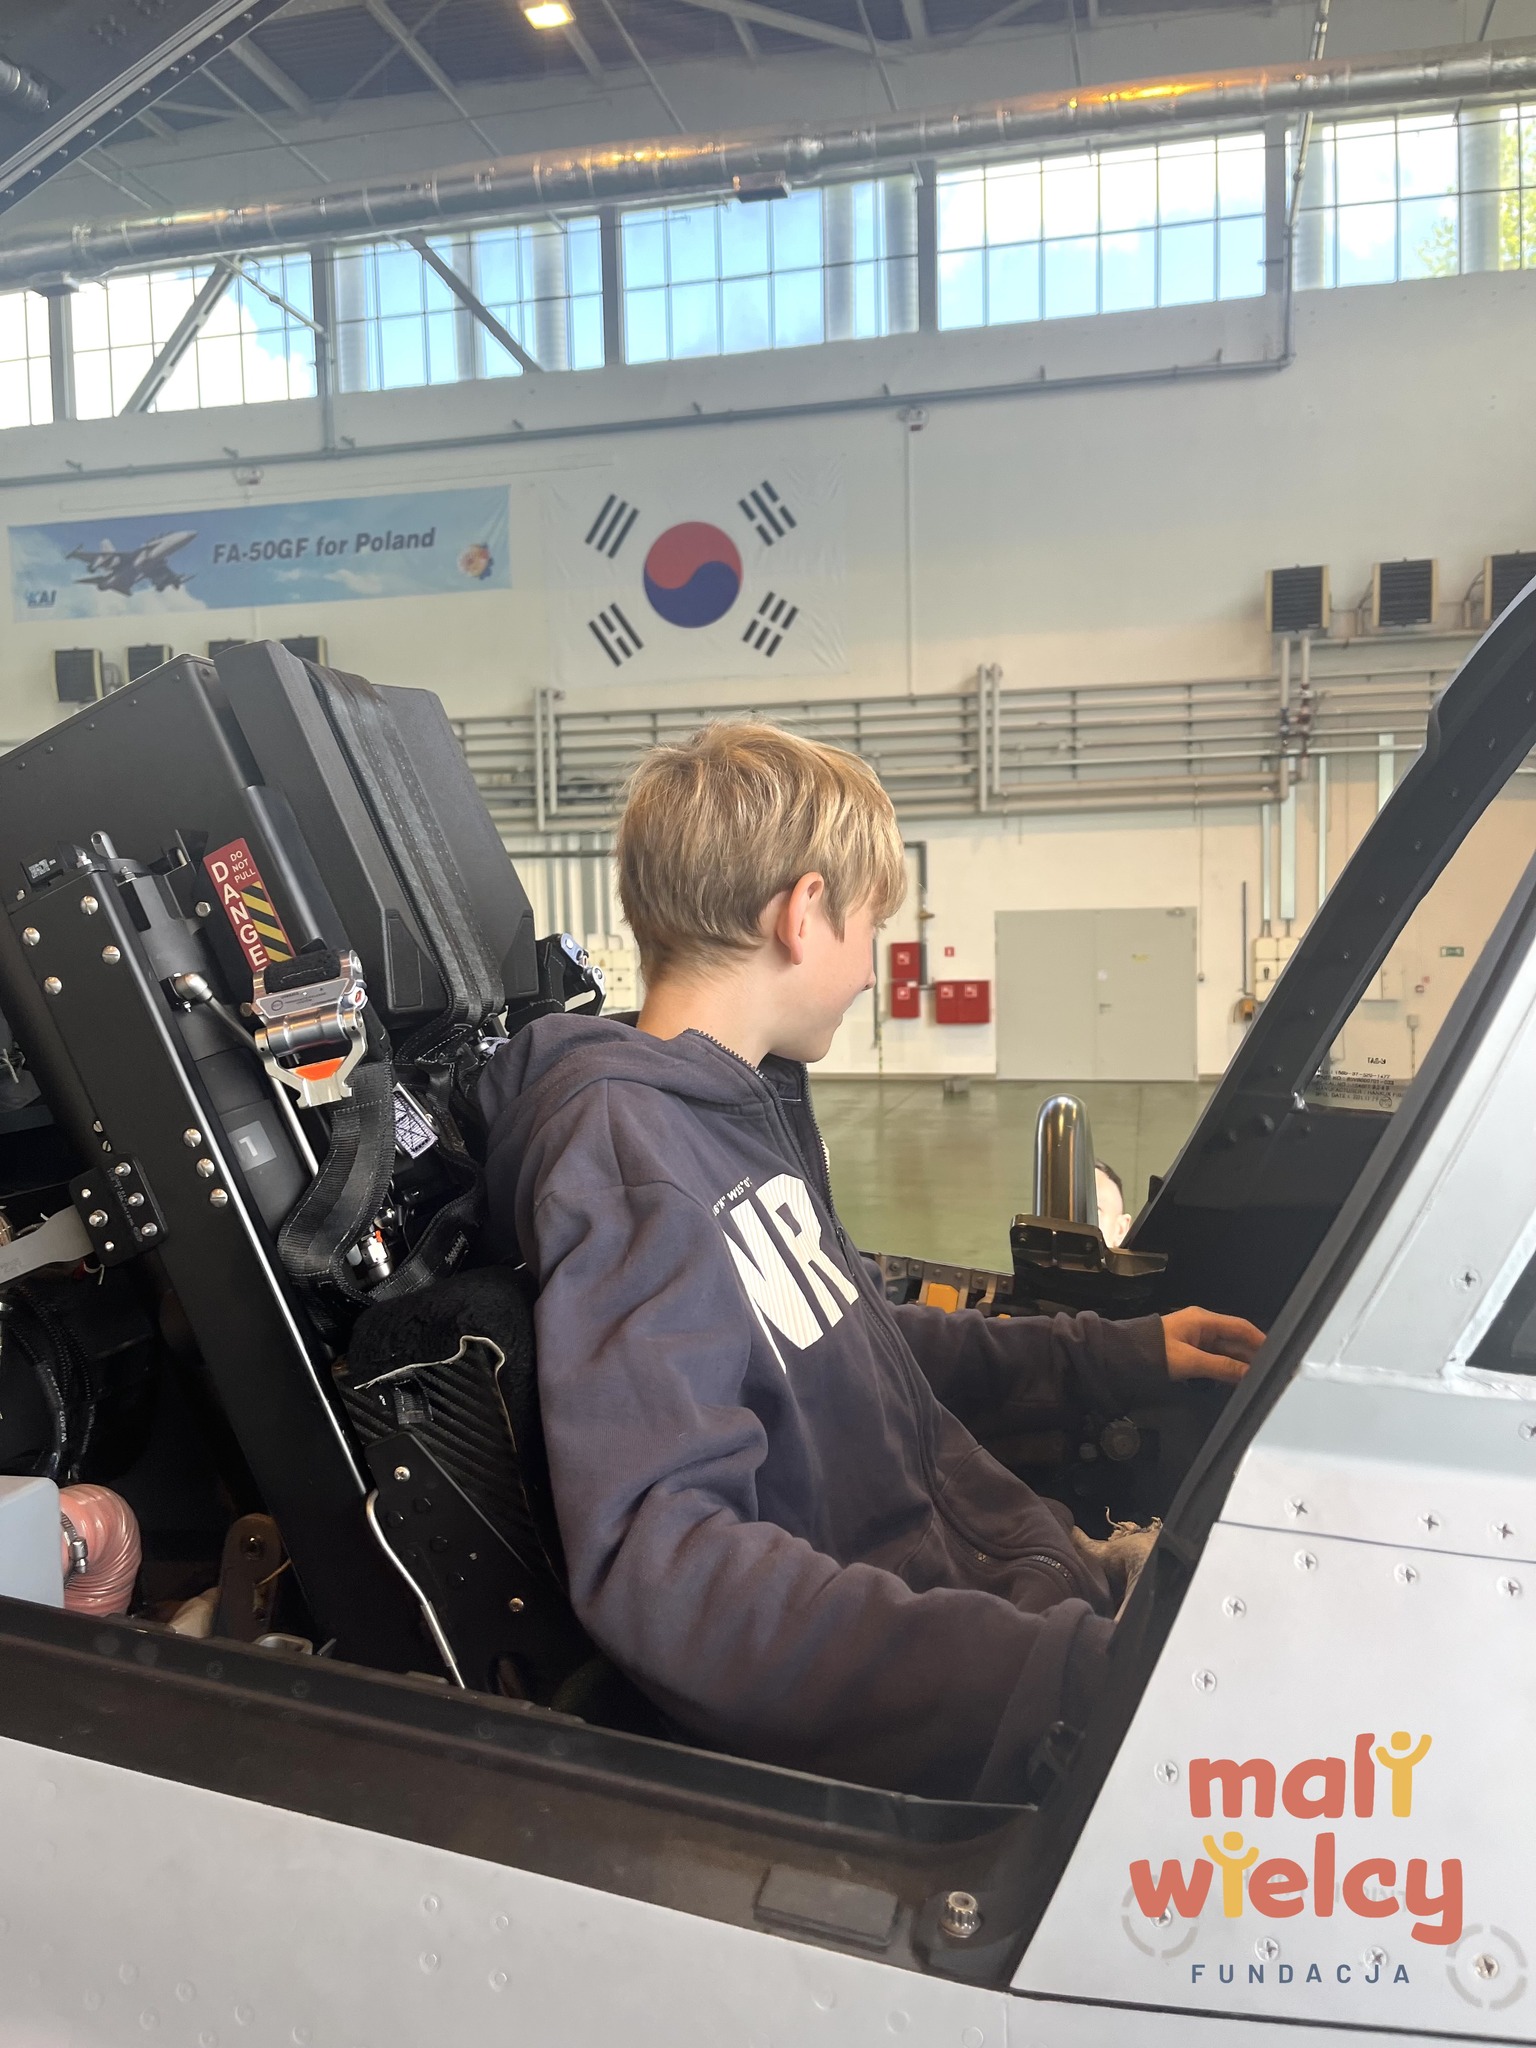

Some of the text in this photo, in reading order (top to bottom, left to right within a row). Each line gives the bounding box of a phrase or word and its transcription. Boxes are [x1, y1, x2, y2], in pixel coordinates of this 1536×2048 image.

[213, 527, 437, 564] FA-50GF for Poland
[230, 850, 243, 862] DO
[232, 858, 249, 873] NOT
[234, 868, 256, 883] PULL
[211, 861, 268, 972] DANGE
